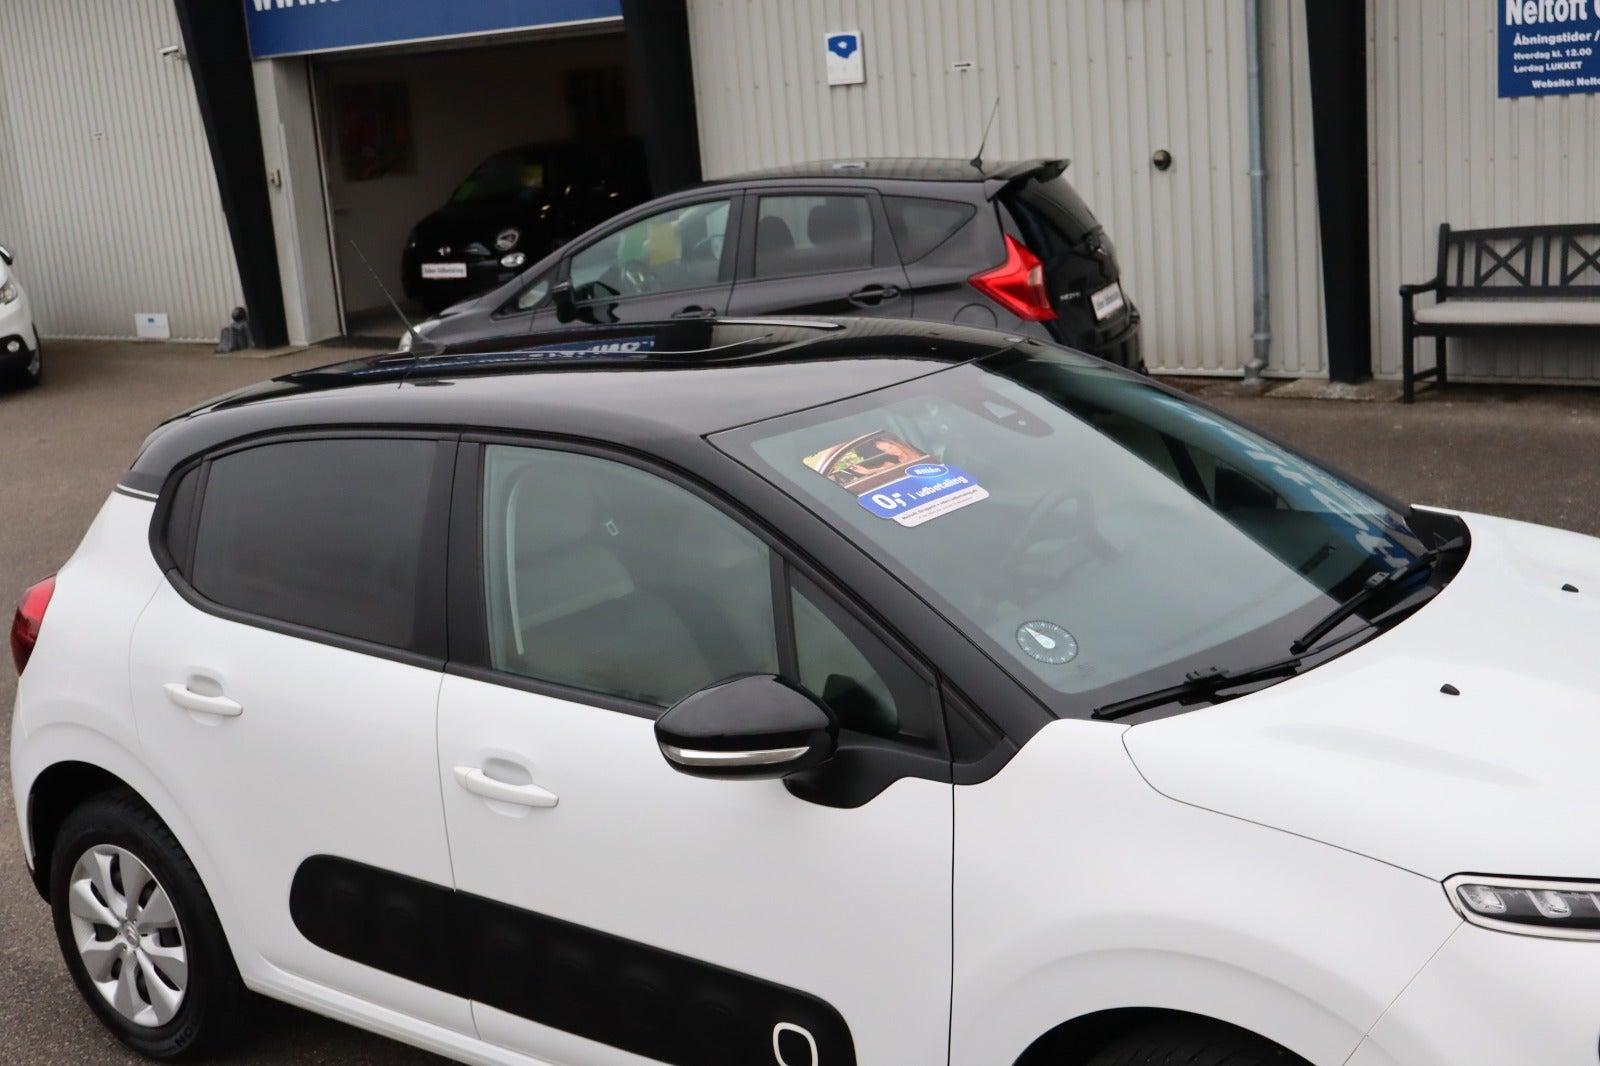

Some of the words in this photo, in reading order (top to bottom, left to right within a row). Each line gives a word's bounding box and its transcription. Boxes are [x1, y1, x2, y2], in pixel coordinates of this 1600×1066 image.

[1513, 31, 1592, 46] Åbningstider
[1513, 51, 1550, 60] Hverdag
[1565, 47, 1592, 57] 12.00
[1545, 61, 1582, 71] LUKKET
[1531, 78, 1574, 89] Website:
[915, 475, 969, 498] udbetaling
